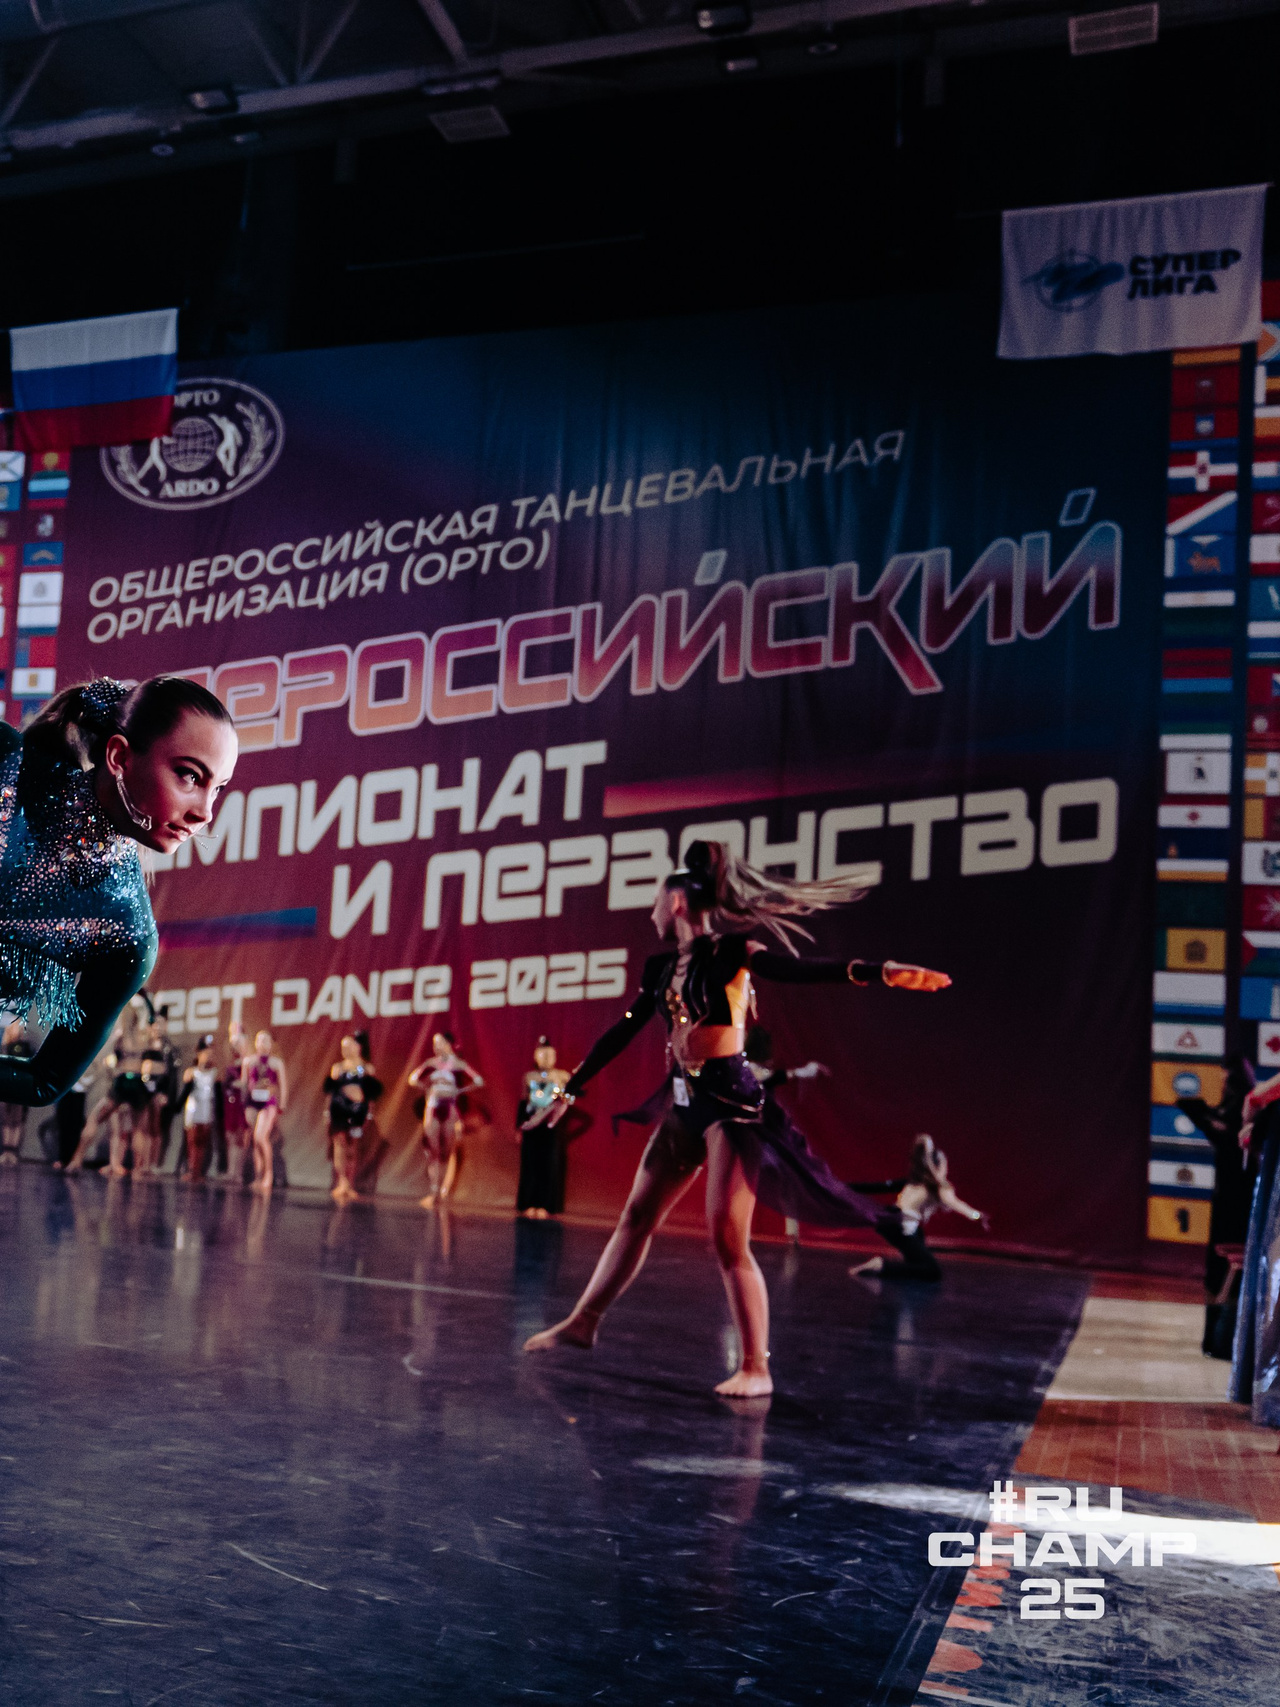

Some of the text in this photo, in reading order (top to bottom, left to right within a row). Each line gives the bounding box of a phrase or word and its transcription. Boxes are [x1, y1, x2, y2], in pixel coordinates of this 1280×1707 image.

[1127, 275, 1218, 300] ЛИГА
[1128, 248, 1242, 276] СУПЕР
[174, 389, 220, 408] РТО
[88, 430, 906, 608] ОБЩЕРОССИЙСКАЯ ТАНЦЕВАЛЬНАЯ
[159, 477, 220, 498] ARDO
[86, 529, 551, 644] ОРГАНИЗАЦИЯ (ОРТО)
[121, 488, 1122, 755] ЕРОССИЙСКИЙ
[152, 740, 608, 872] МПИОНАТ
[329, 860, 392, 940] И
[468, 948, 628, 1010] 2025
